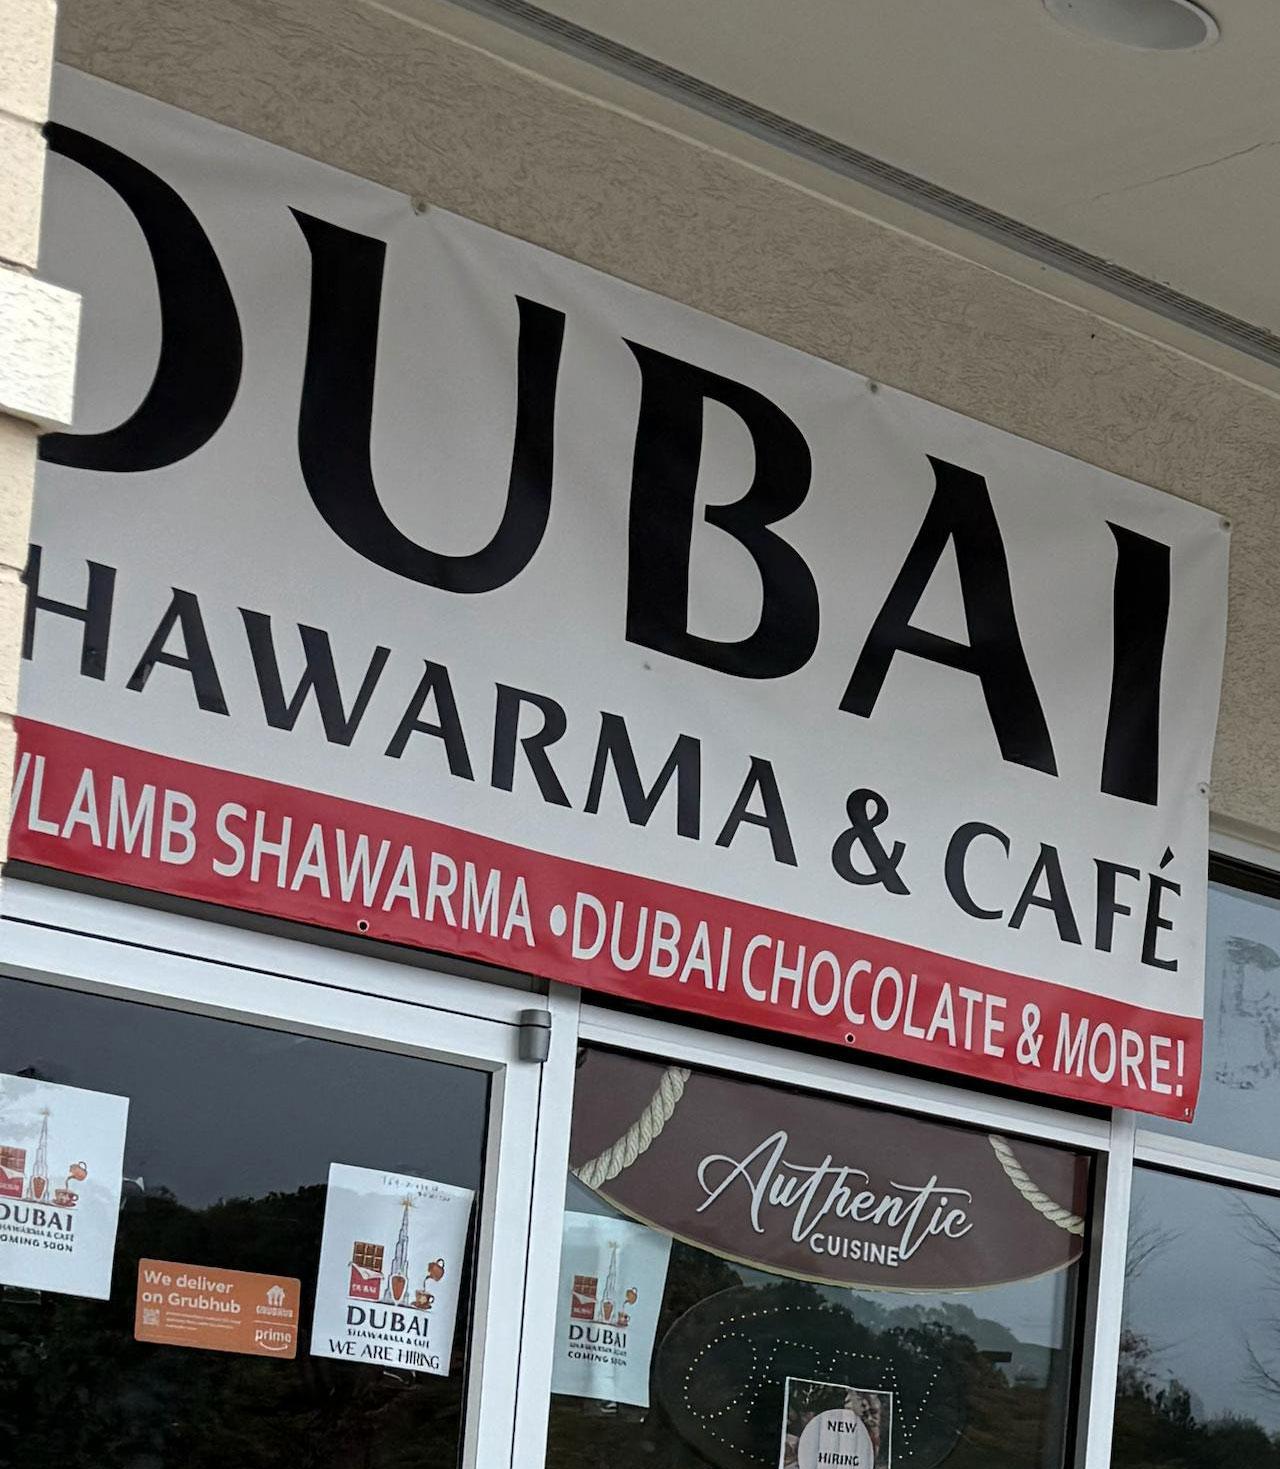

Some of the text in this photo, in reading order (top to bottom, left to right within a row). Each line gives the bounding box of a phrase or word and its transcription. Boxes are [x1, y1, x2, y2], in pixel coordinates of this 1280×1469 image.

[831, 788, 911, 895] &
[944, 846, 1182, 972] CAFÉ
[212, 802, 535, 947] SHAWARMA
[742, 934, 1005, 1058] CHOCOLATE
[1017, 1003, 1043, 1067] &
[1053, 1011, 1185, 1097] MORE!
[697, 1130, 973, 1260] Authentic
[0, 1203, 73, 1232] DUBAI
[43, 1240, 73, 1252] SOON
[810, 1231, 899, 1266] CUISINE
[144, 1270, 234, 1294] We deliver
[142, 1292, 241, 1314] on Grubhub
[347, 1305, 429, 1337] DUBAI
[569, 1324, 627, 1348] DUBAI
[329, 1339, 440, 1370] WE ARE HIRING
[568, 1351, 609, 1363] COMING
[827, 1420, 858, 1433] NEW
[818, 1451, 860, 1467] HIRING
